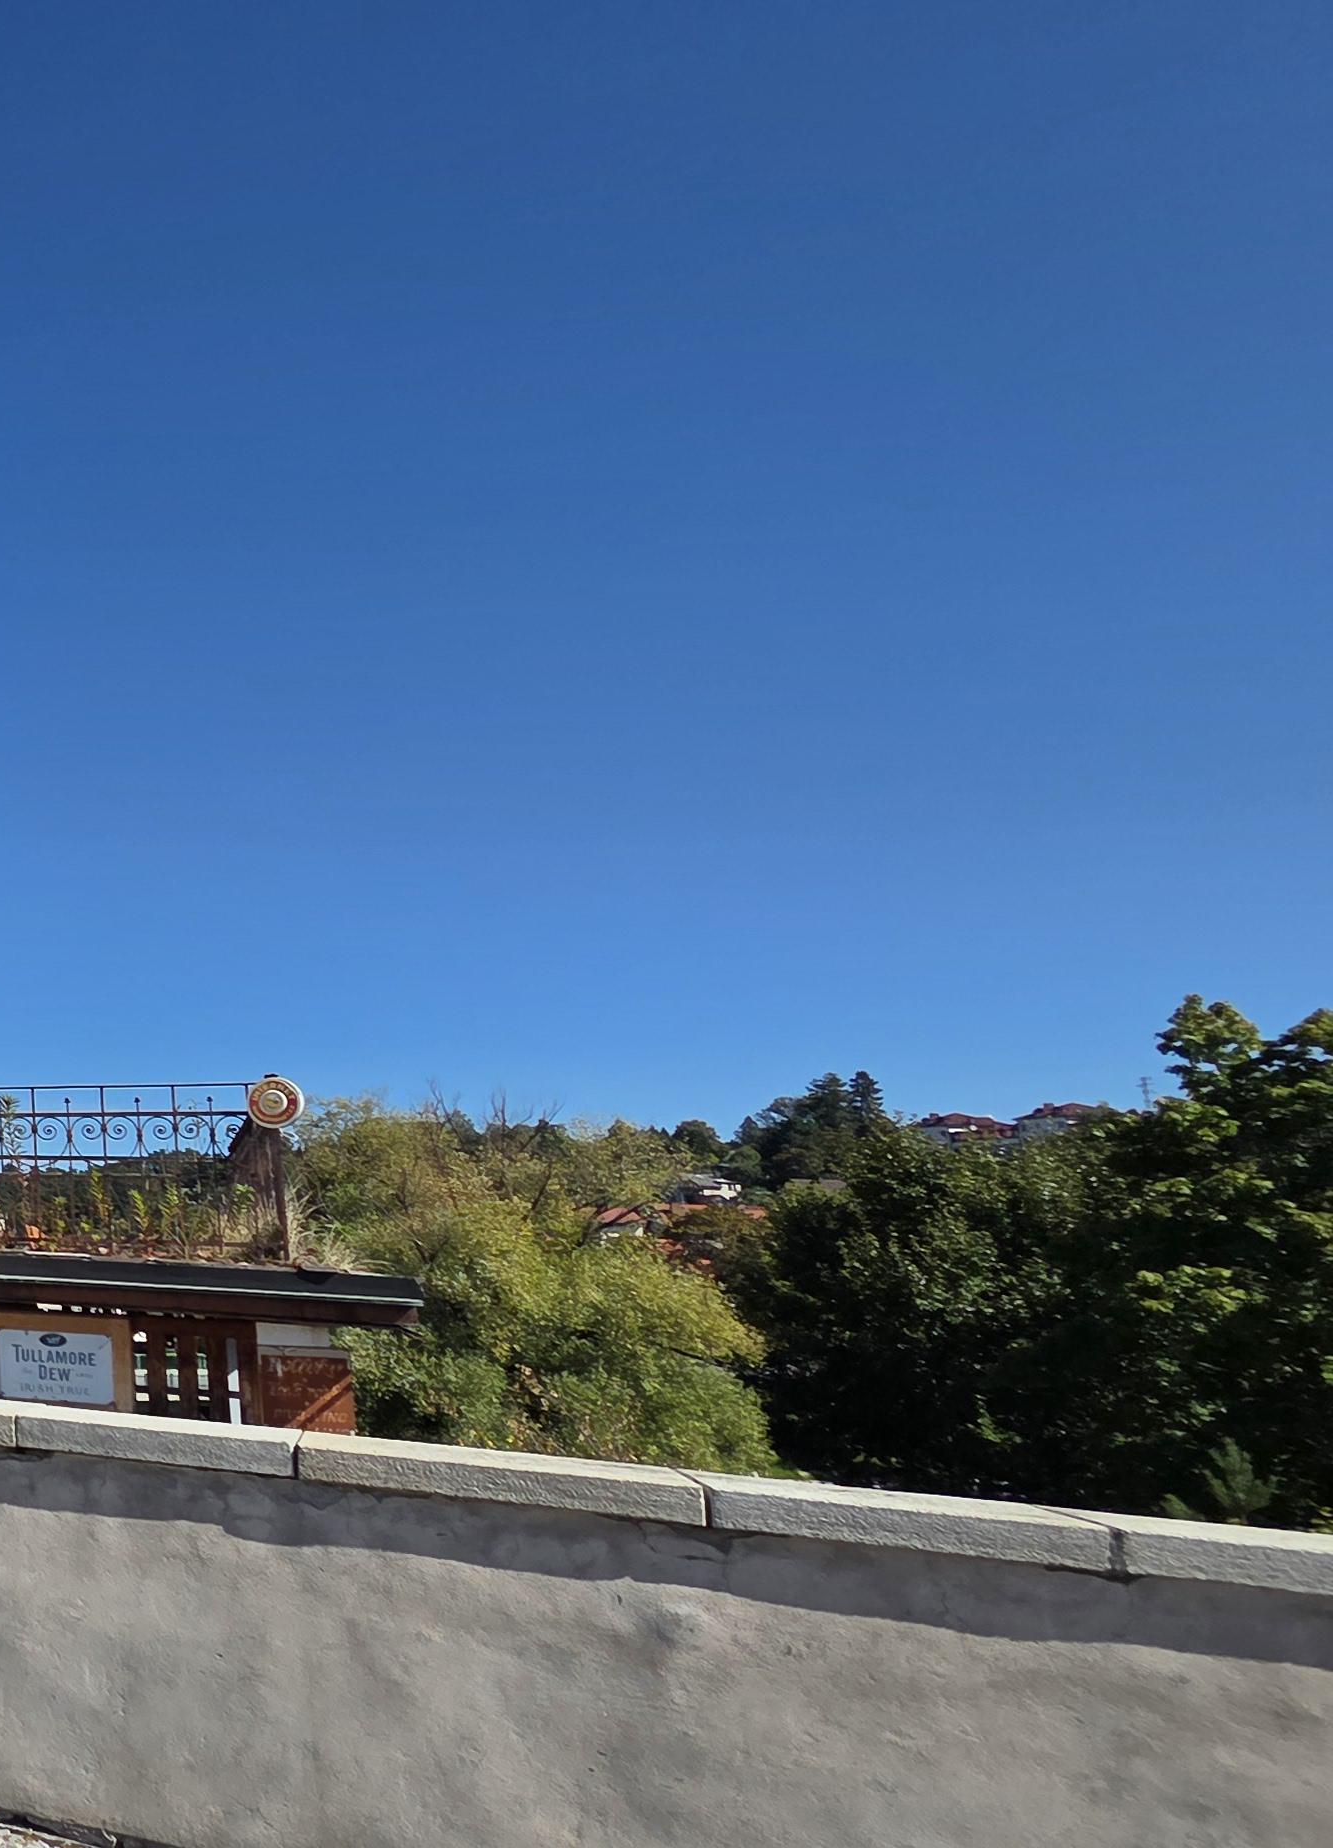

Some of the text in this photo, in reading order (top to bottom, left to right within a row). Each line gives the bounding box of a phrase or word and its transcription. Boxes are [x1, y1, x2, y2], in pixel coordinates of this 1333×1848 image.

[11, 1343, 97, 1367] TULLAMORE
[38, 1364, 71, 1382] DEW
[20, 1382, 91, 1396] IRISH TRUE
